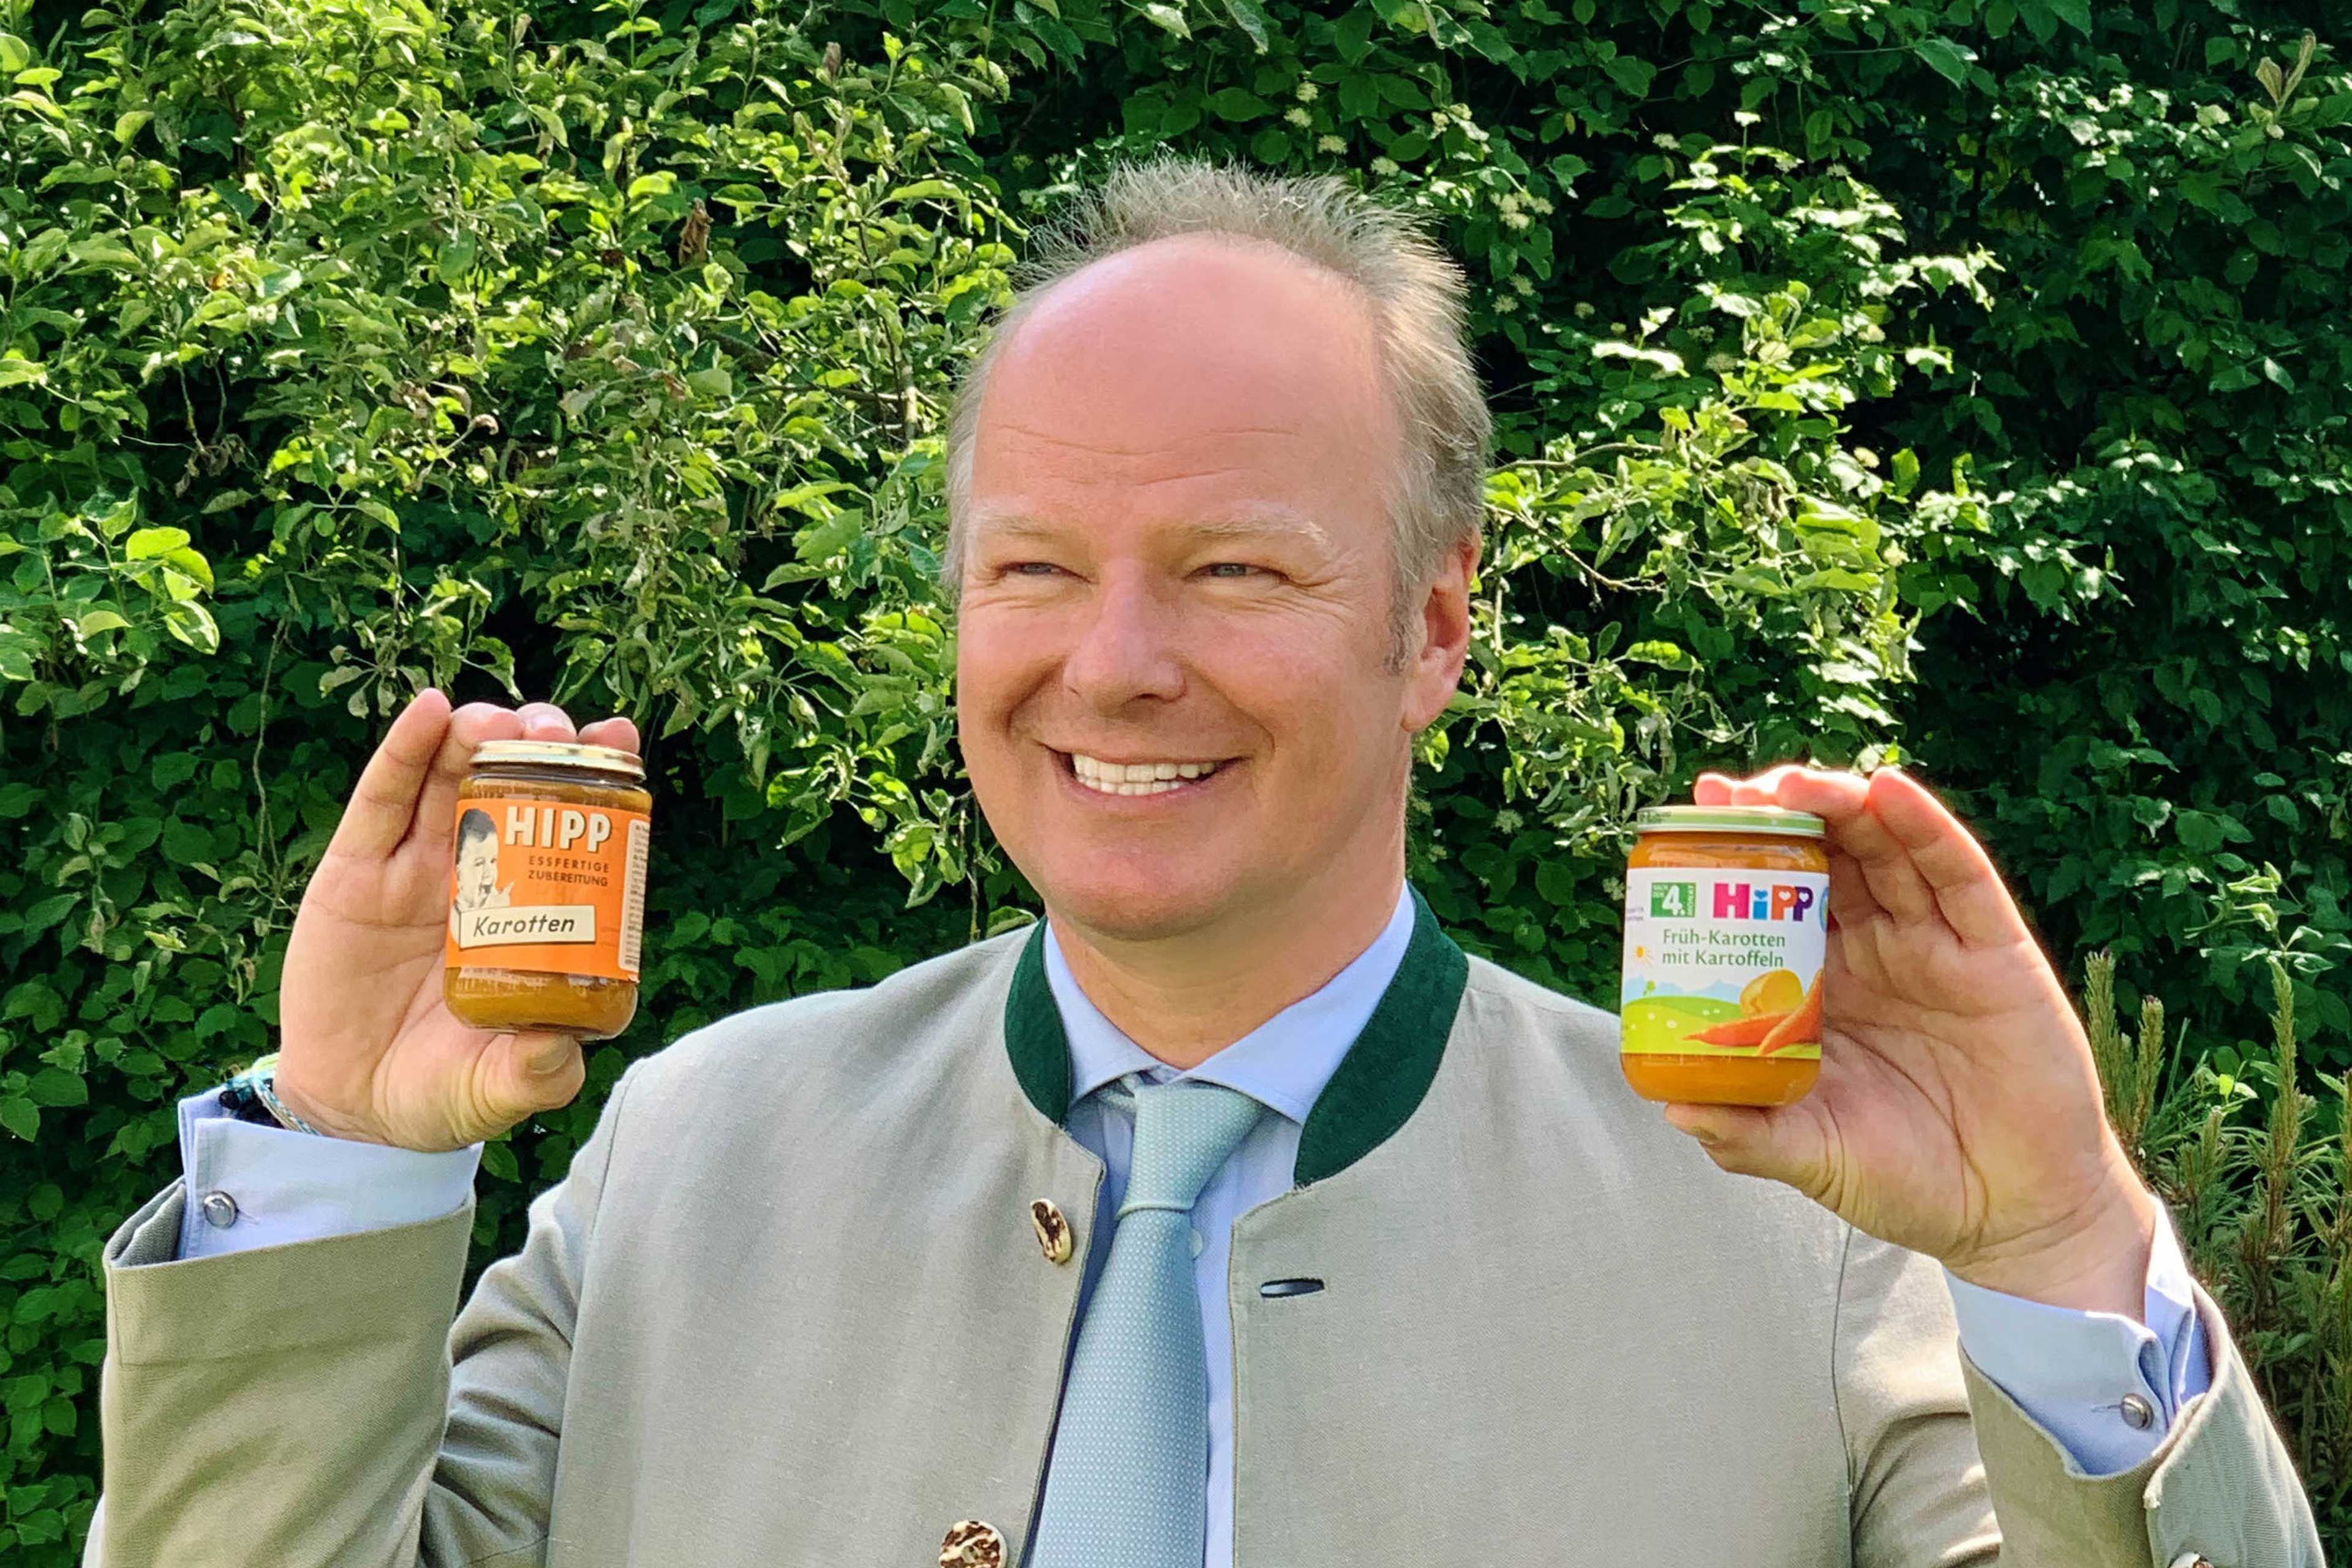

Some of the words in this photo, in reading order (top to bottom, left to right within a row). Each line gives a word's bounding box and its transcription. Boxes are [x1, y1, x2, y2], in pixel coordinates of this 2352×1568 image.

[505, 806, 611, 853] HIPP
[529, 856, 610, 873] ESSFERTIGE
[528, 870, 609, 887] ZUBEREITUNG
[473, 914, 575, 937] Karotten
[1663, 929, 1785, 947] Früh-Karotten
[1662, 949, 1689, 964] mit
[1695, 950, 1784, 967] Kartoffeln
